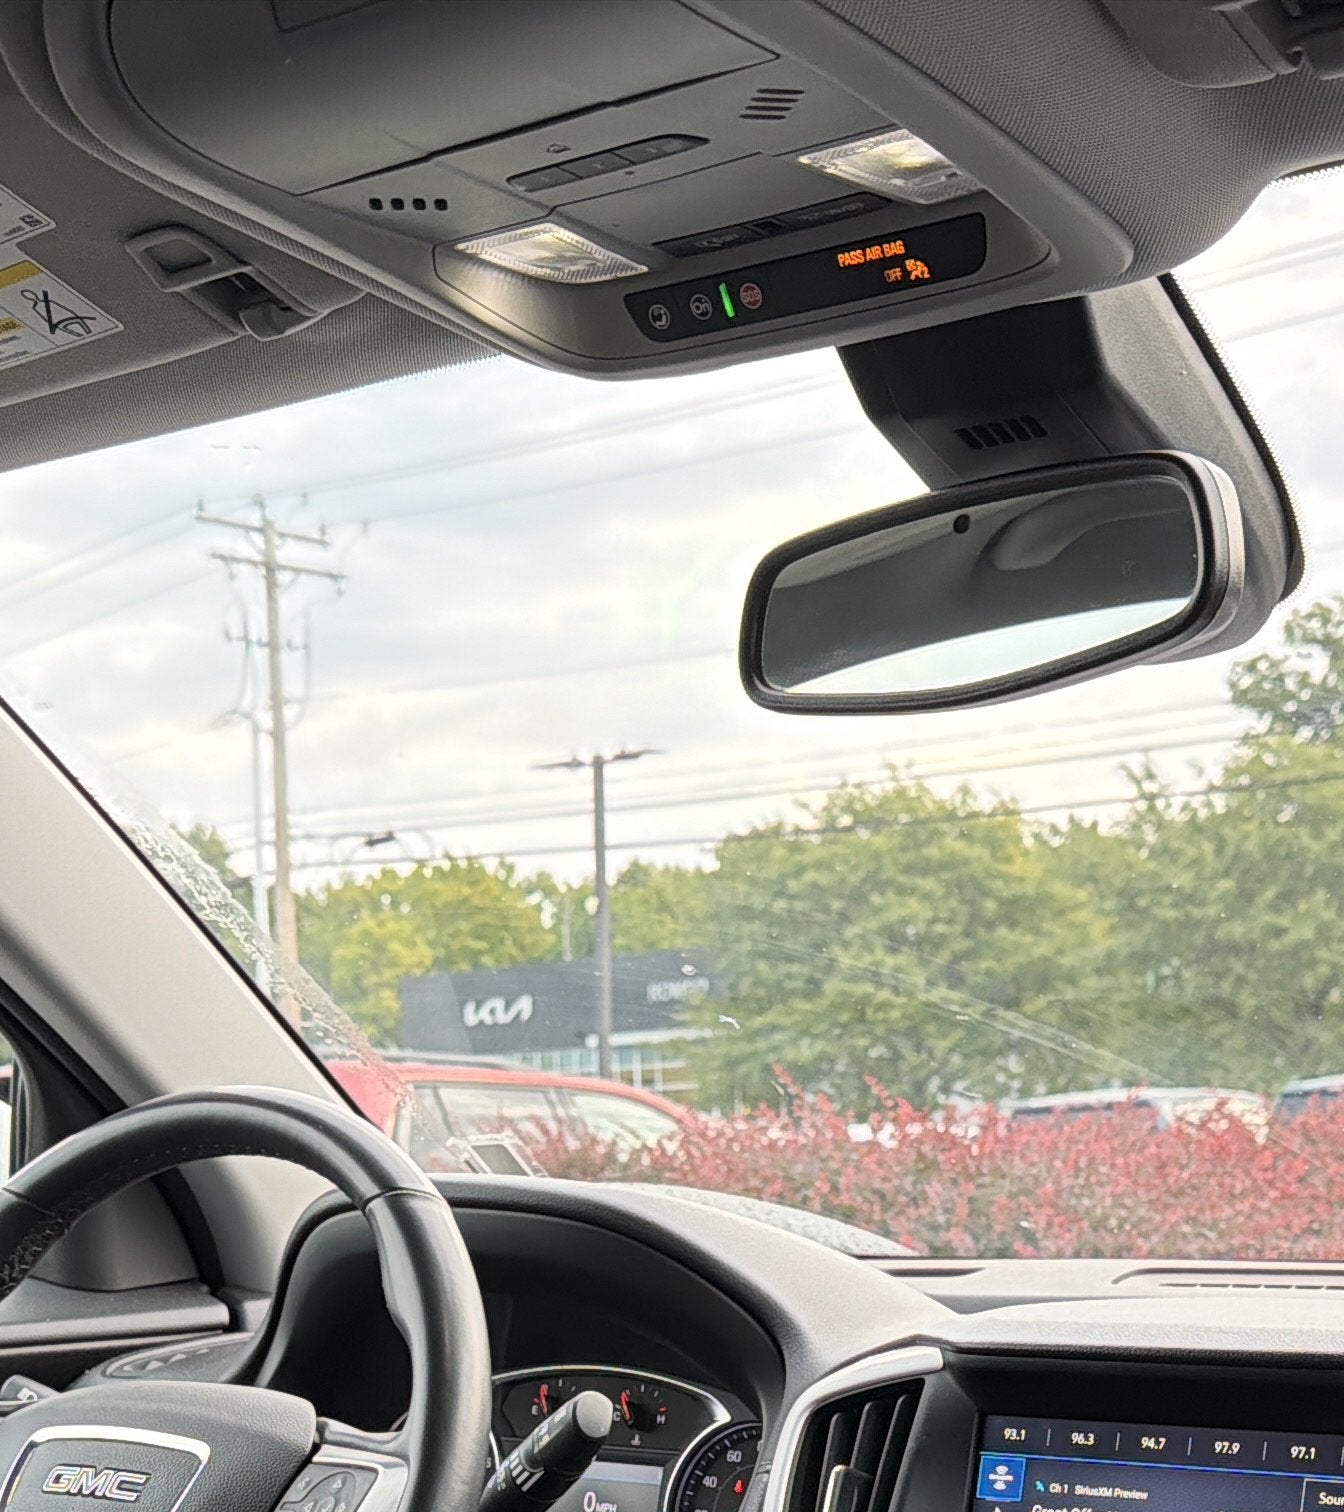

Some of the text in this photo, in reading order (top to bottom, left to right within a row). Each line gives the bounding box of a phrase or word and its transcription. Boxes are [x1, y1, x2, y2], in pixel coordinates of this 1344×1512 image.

[837, 240, 905, 268] PASS AIR BAG
[884, 267, 903, 283] OFF
[531, 1405, 538, 1415] E
[1003, 1428, 1026, 1441] 93.1
[1071, 1432, 1094, 1446] 96.3
[1141, 1436, 1166, 1450] 94.7
[1214, 1441, 1240, 1455] 97.9
[726, 1450, 742, 1463] 60
[1290, 1445, 1316, 1460] 97.1
[43, 1464, 151, 1501] GMC
[702, 1475, 717, 1488] 40
[1049, 1482, 1148, 1500] Ch 1 SiriusXM Preview
[583, 1491, 596, 1512] 0
